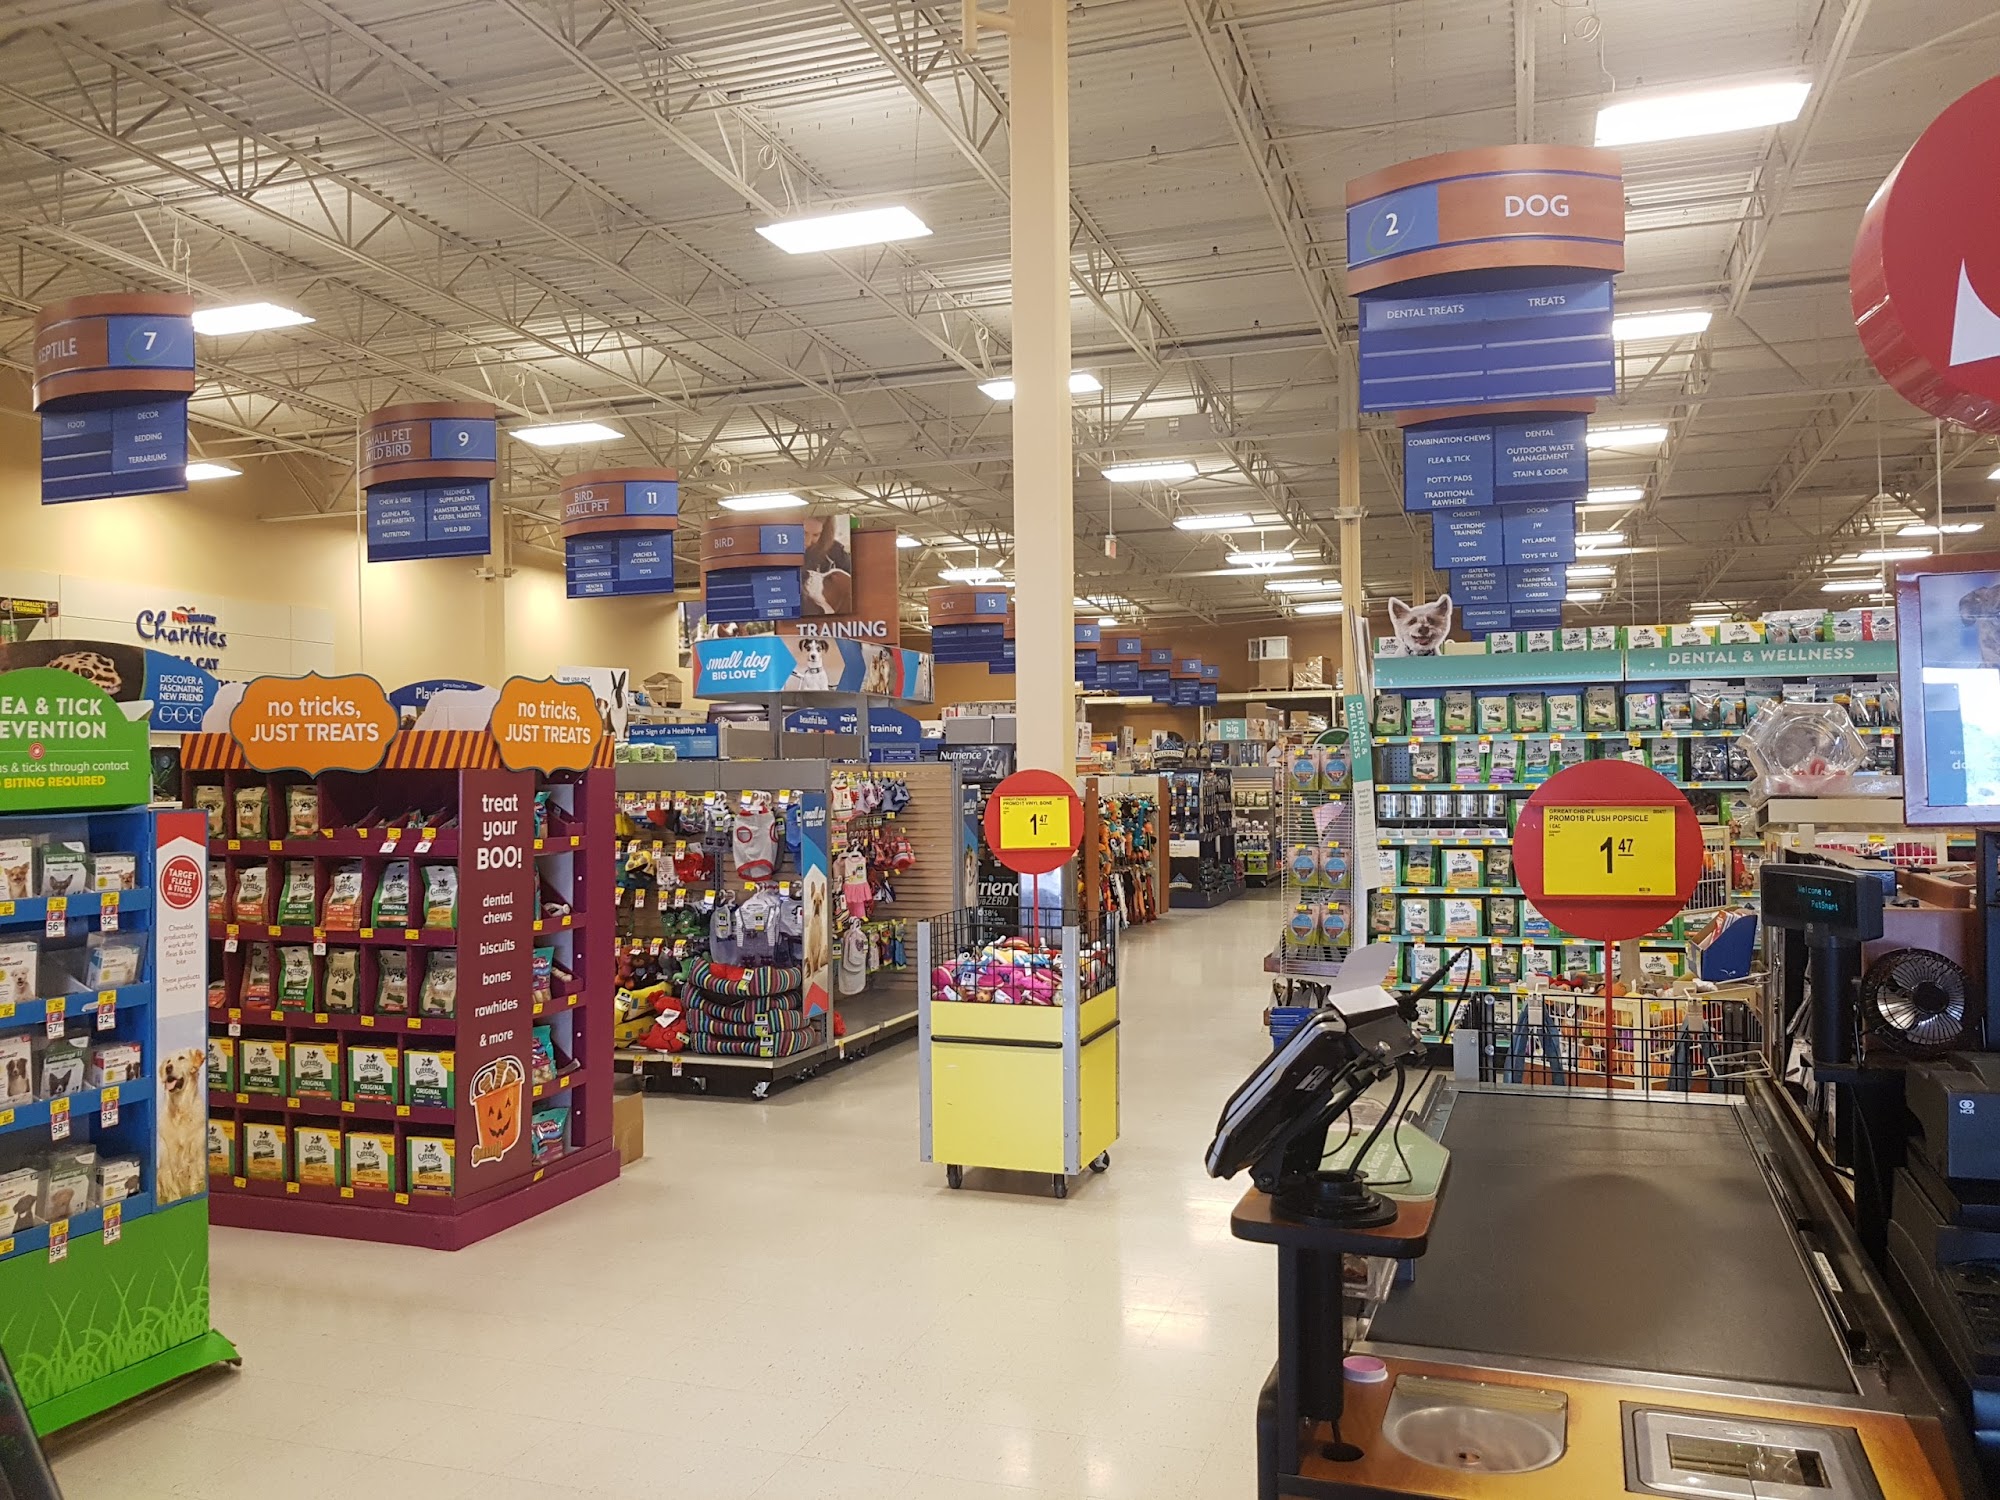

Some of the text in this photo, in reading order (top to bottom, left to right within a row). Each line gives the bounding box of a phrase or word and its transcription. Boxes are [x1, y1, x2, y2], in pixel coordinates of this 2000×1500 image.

[1504, 194, 1570, 218] DOG
[1385, 213, 1399, 237] 2
[1527, 295, 1566, 307] TREATS
[1386, 304, 1465, 319] DENTAL TREATS
[143, 331, 157, 351] 7
[137, 410, 159, 420] DECOR
[67, 420, 86, 429] FOOD
[134, 432, 163, 443] BEDDING
[365, 428, 412, 448] SMALL PET
[458, 431, 469, 447] 9
[1408, 433, 1491, 447] COMBINATION CHEWS
[1525, 430, 1555, 438] DENTAL
[365, 443, 412, 463] WILD BIRD
[1507, 444, 1575, 455] OUTDOOR WASTE
[128, 453, 168, 465] TERRARIUMS
[1427, 456, 1445, 464] FLEA
[1513, 453, 1569, 463] MANAGEMENT
[1427, 474, 1472, 484] POTTY PADS
[1513, 469, 1535, 478] STAIN
[1544, 468, 1569, 476] ODOR
[574, 490, 594, 503] BIRD
[647, 492, 657, 505] 11
[1424, 489, 1475, 499] TRADITIONAL
[1432, 498, 1467, 506] RAWHIDE
[566, 501, 609, 517] SMALL PET
[1450, 522, 1486, 530] ELECTRONIC
[714, 537, 735, 549] BIRD
[776, 534, 788, 545] 13
[941, 601, 955, 610] CAT
[987, 598, 996, 608] 15
[136, 610, 228, 648] Charities
[796, 620, 887, 639] TRAINING
[1084, 629, 1092, 637] 19
[1126, 642, 1133, 650] 21
[1668, 647, 1855, 666] DENTAL & WELLNESS
[196, 657, 219, 670] CAT
[706, 650, 772, 677] small dog
[160, 675, 196, 685] DISCOVER
[712, 668, 757, 681] BIG LOVE
[160, 684, 204, 694] FASCINATING
[159, 693, 204, 702] NEW FRIEND
[35, 697, 103, 715] & TICK
[268, 696, 361, 719] no tricks,
[518, 701, 580, 722] no tricks,
[799, 715, 818, 724] Beautiful
[1356, 702, 1367, 744] DENTAL
[250, 722, 380, 742] JUST TREATS
[505, 724, 591, 744] JUST TREATS
[646, 728, 658, 737] Sign
[672, 728, 695, 736] Healthy
[870, 725, 902, 735] training
[1226, 725, 1239, 736] big
[1349, 703, 1361, 759] WELLNESS
[940, 751, 981, 761] Nutrience
[11, 762, 19, 772] &
[22, 762, 47, 772] ticks
[50, 762, 90, 773] through
[92, 761, 129, 771] contact
[4, 776, 106, 788] BITING REQUIRED
[482, 794, 518, 812] treat
[483, 819, 517, 841] your
[1030, 814, 1048, 835] 1 47
[477, 846, 522, 870] BOO!
[1600, 837, 1634, 874] 1 47
[169, 867, 198, 880] TARGET
[171, 877, 192, 887] FLEAS
[174, 884, 193, 894] TICKS
[978, 881, 1019, 897] rienc
[1798, 886, 1832, 897] Welcome to
[482, 892, 513, 907] dental
[986, 896, 1009, 905] ZERO
[1811, 900, 1839, 912] PetSmart
[102, 916, 112, 925] 32
[483, 911, 512, 924] chews
[47, 921, 58, 931] 56
[168, 923, 194, 931] Chewable
[163, 931, 198, 942] products only
[479, 939, 515, 956] biscuits
[178, 973, 200, 983] products
[482, 971, 511, 986] bones
[179, 982, 196, 990] before
[475, 998, 518, 1018] rawhides
[98, 1014, 109, 1024] 32
[48, 1023, 58, 1033] 57
[480, 1029, 513, 1046] & more
[415, 1088, 440, 1096] ORIGINAL
[102, 1112, 112, 1121] 33
[53, 1124, 63, 1134] 58
[104, 1229, 114, 1239] 34
[50, 1247, 60, 1256] 59
